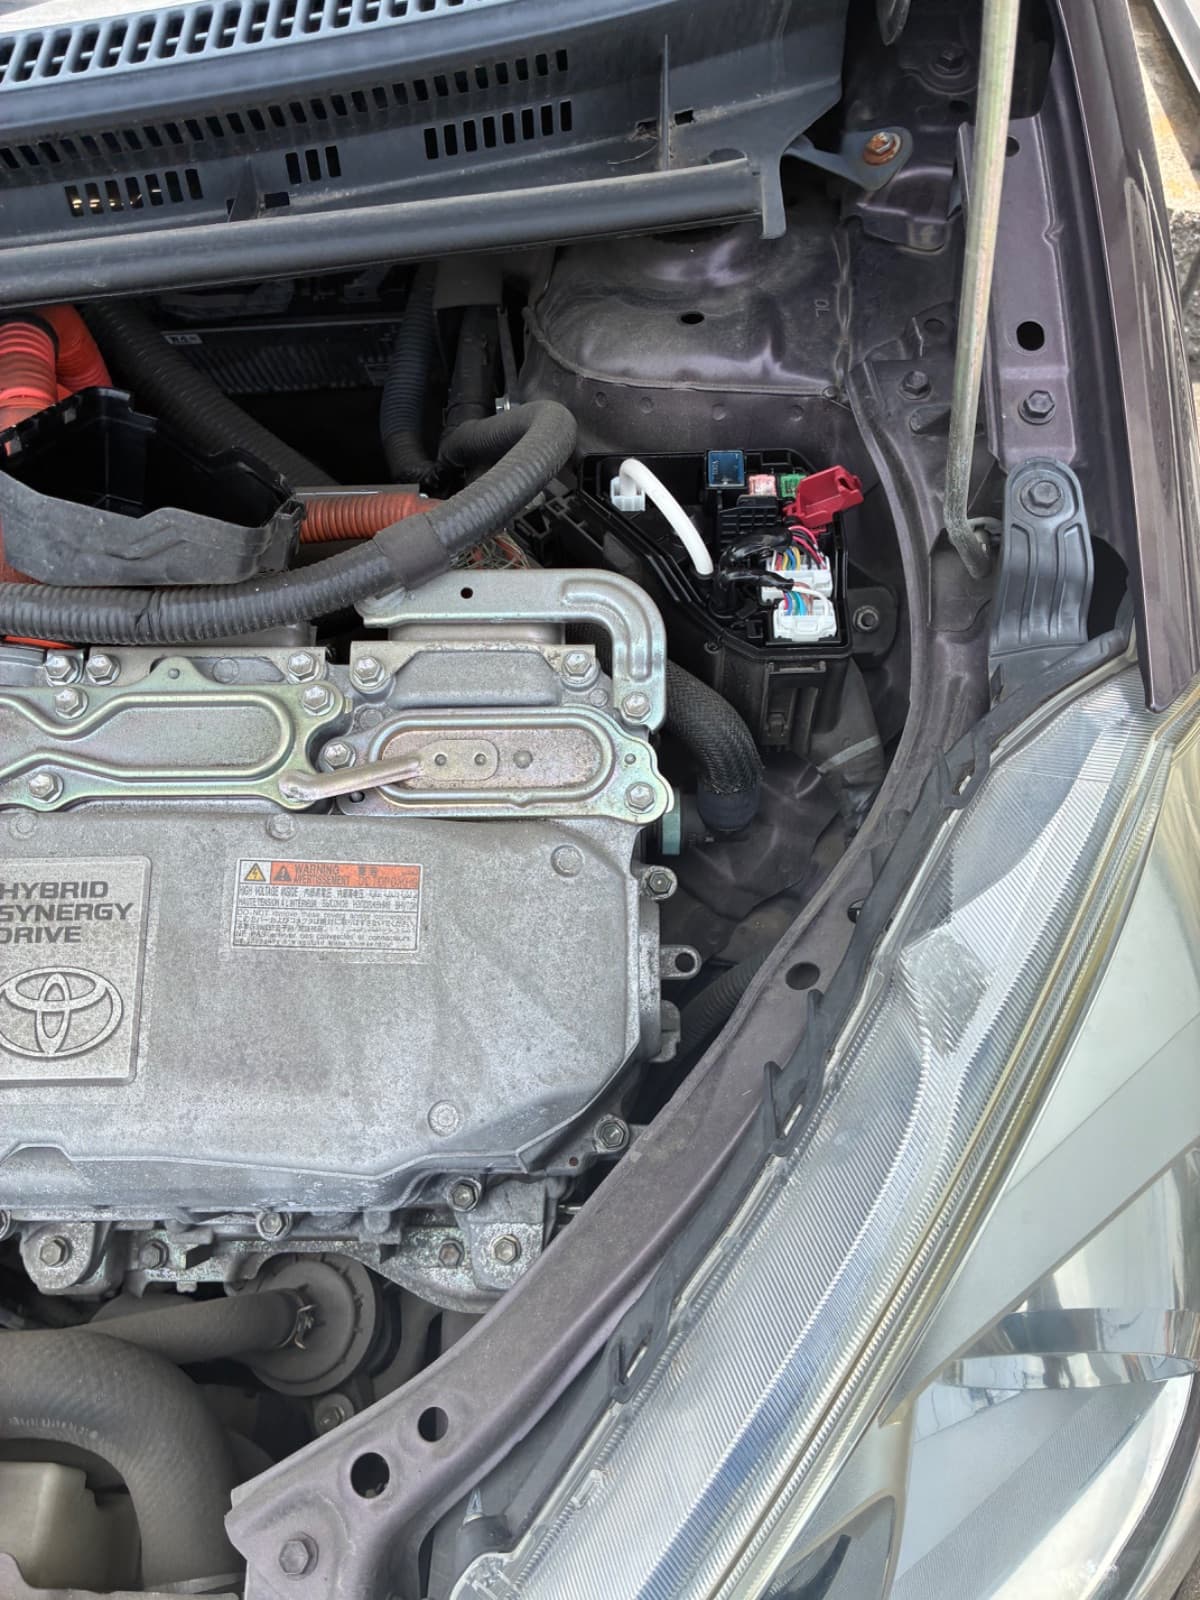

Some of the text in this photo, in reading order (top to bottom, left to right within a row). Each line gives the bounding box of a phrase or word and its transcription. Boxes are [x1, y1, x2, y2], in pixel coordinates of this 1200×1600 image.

[294, 863, 340, 875] WARNING
[0, 881, 109, 900] HYBRID
[0, 903, 134, 922] SYNERGY
